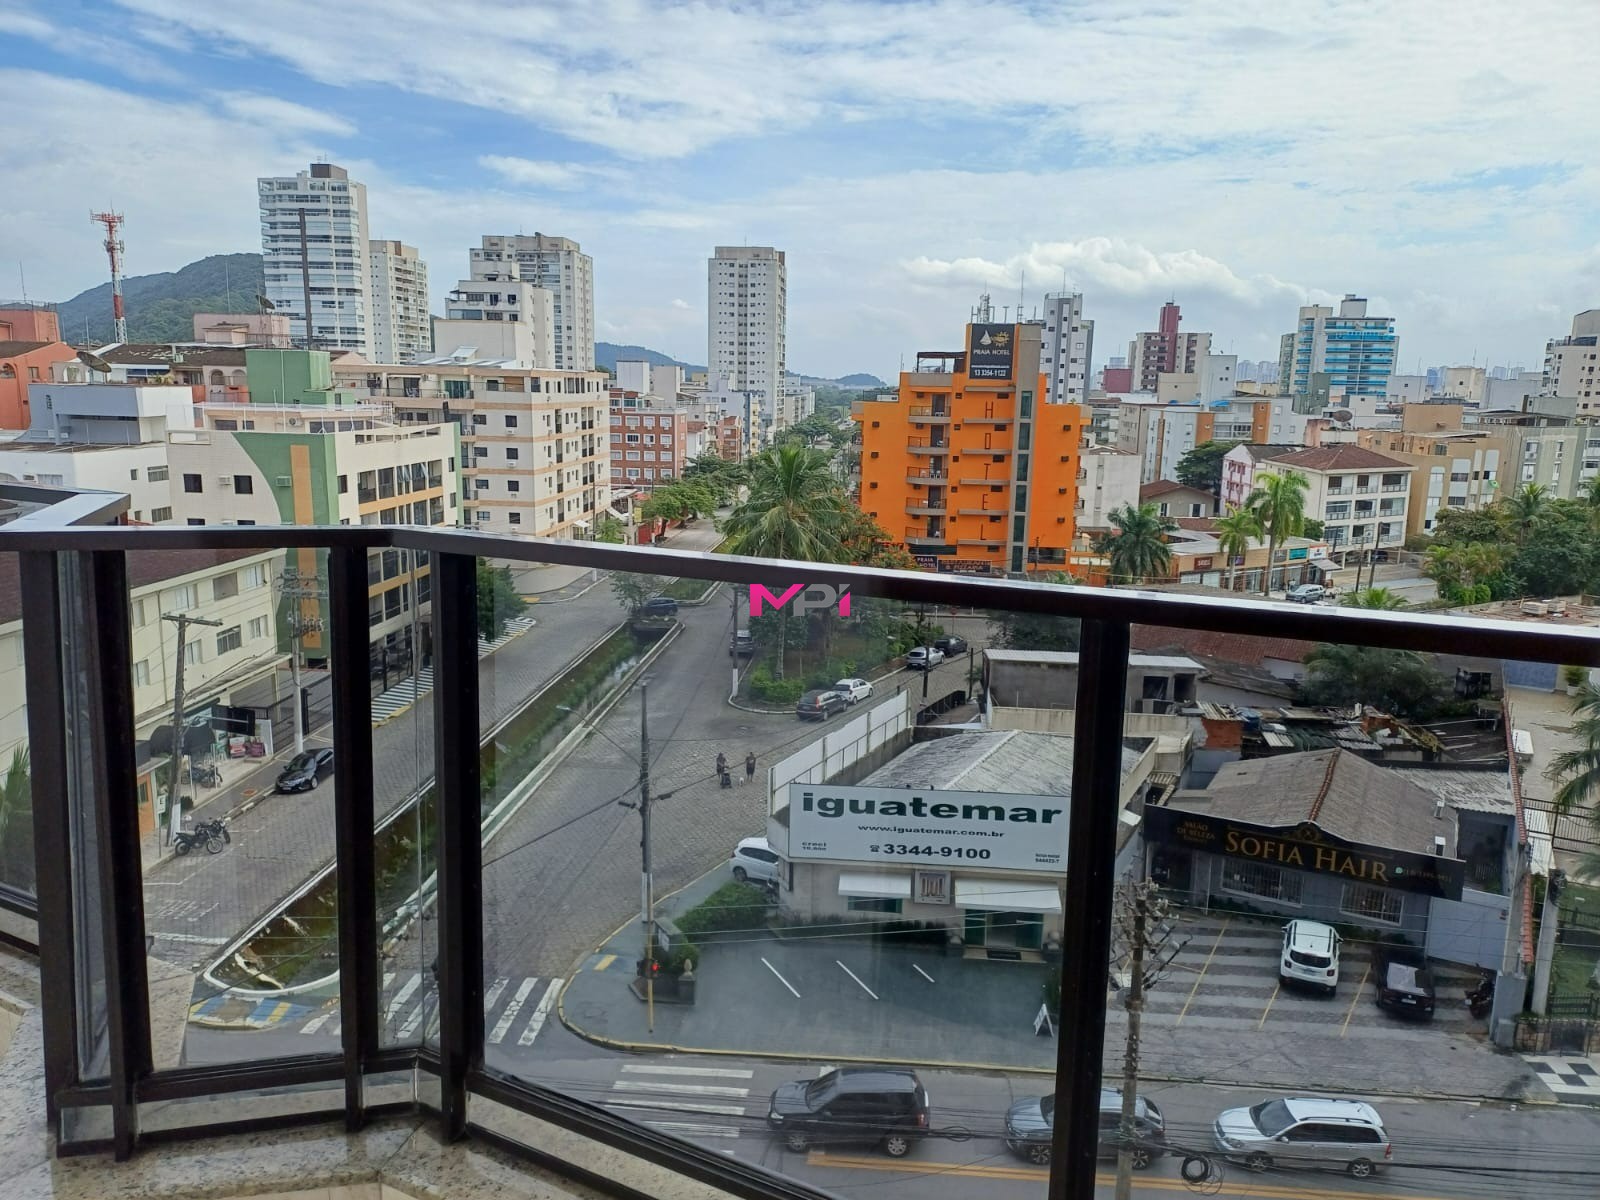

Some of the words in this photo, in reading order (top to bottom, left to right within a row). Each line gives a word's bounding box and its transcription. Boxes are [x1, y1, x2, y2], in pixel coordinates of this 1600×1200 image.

[802, 792, 1063, 824] iguatemar
[857, 825, 1005, 838] www.iguatemar.com.br
[883, 843, 991, 860] 3344-9100
[1225, 831, 1305, 866] SOFIA
[1314, 846, 1390, 882] HAIR
